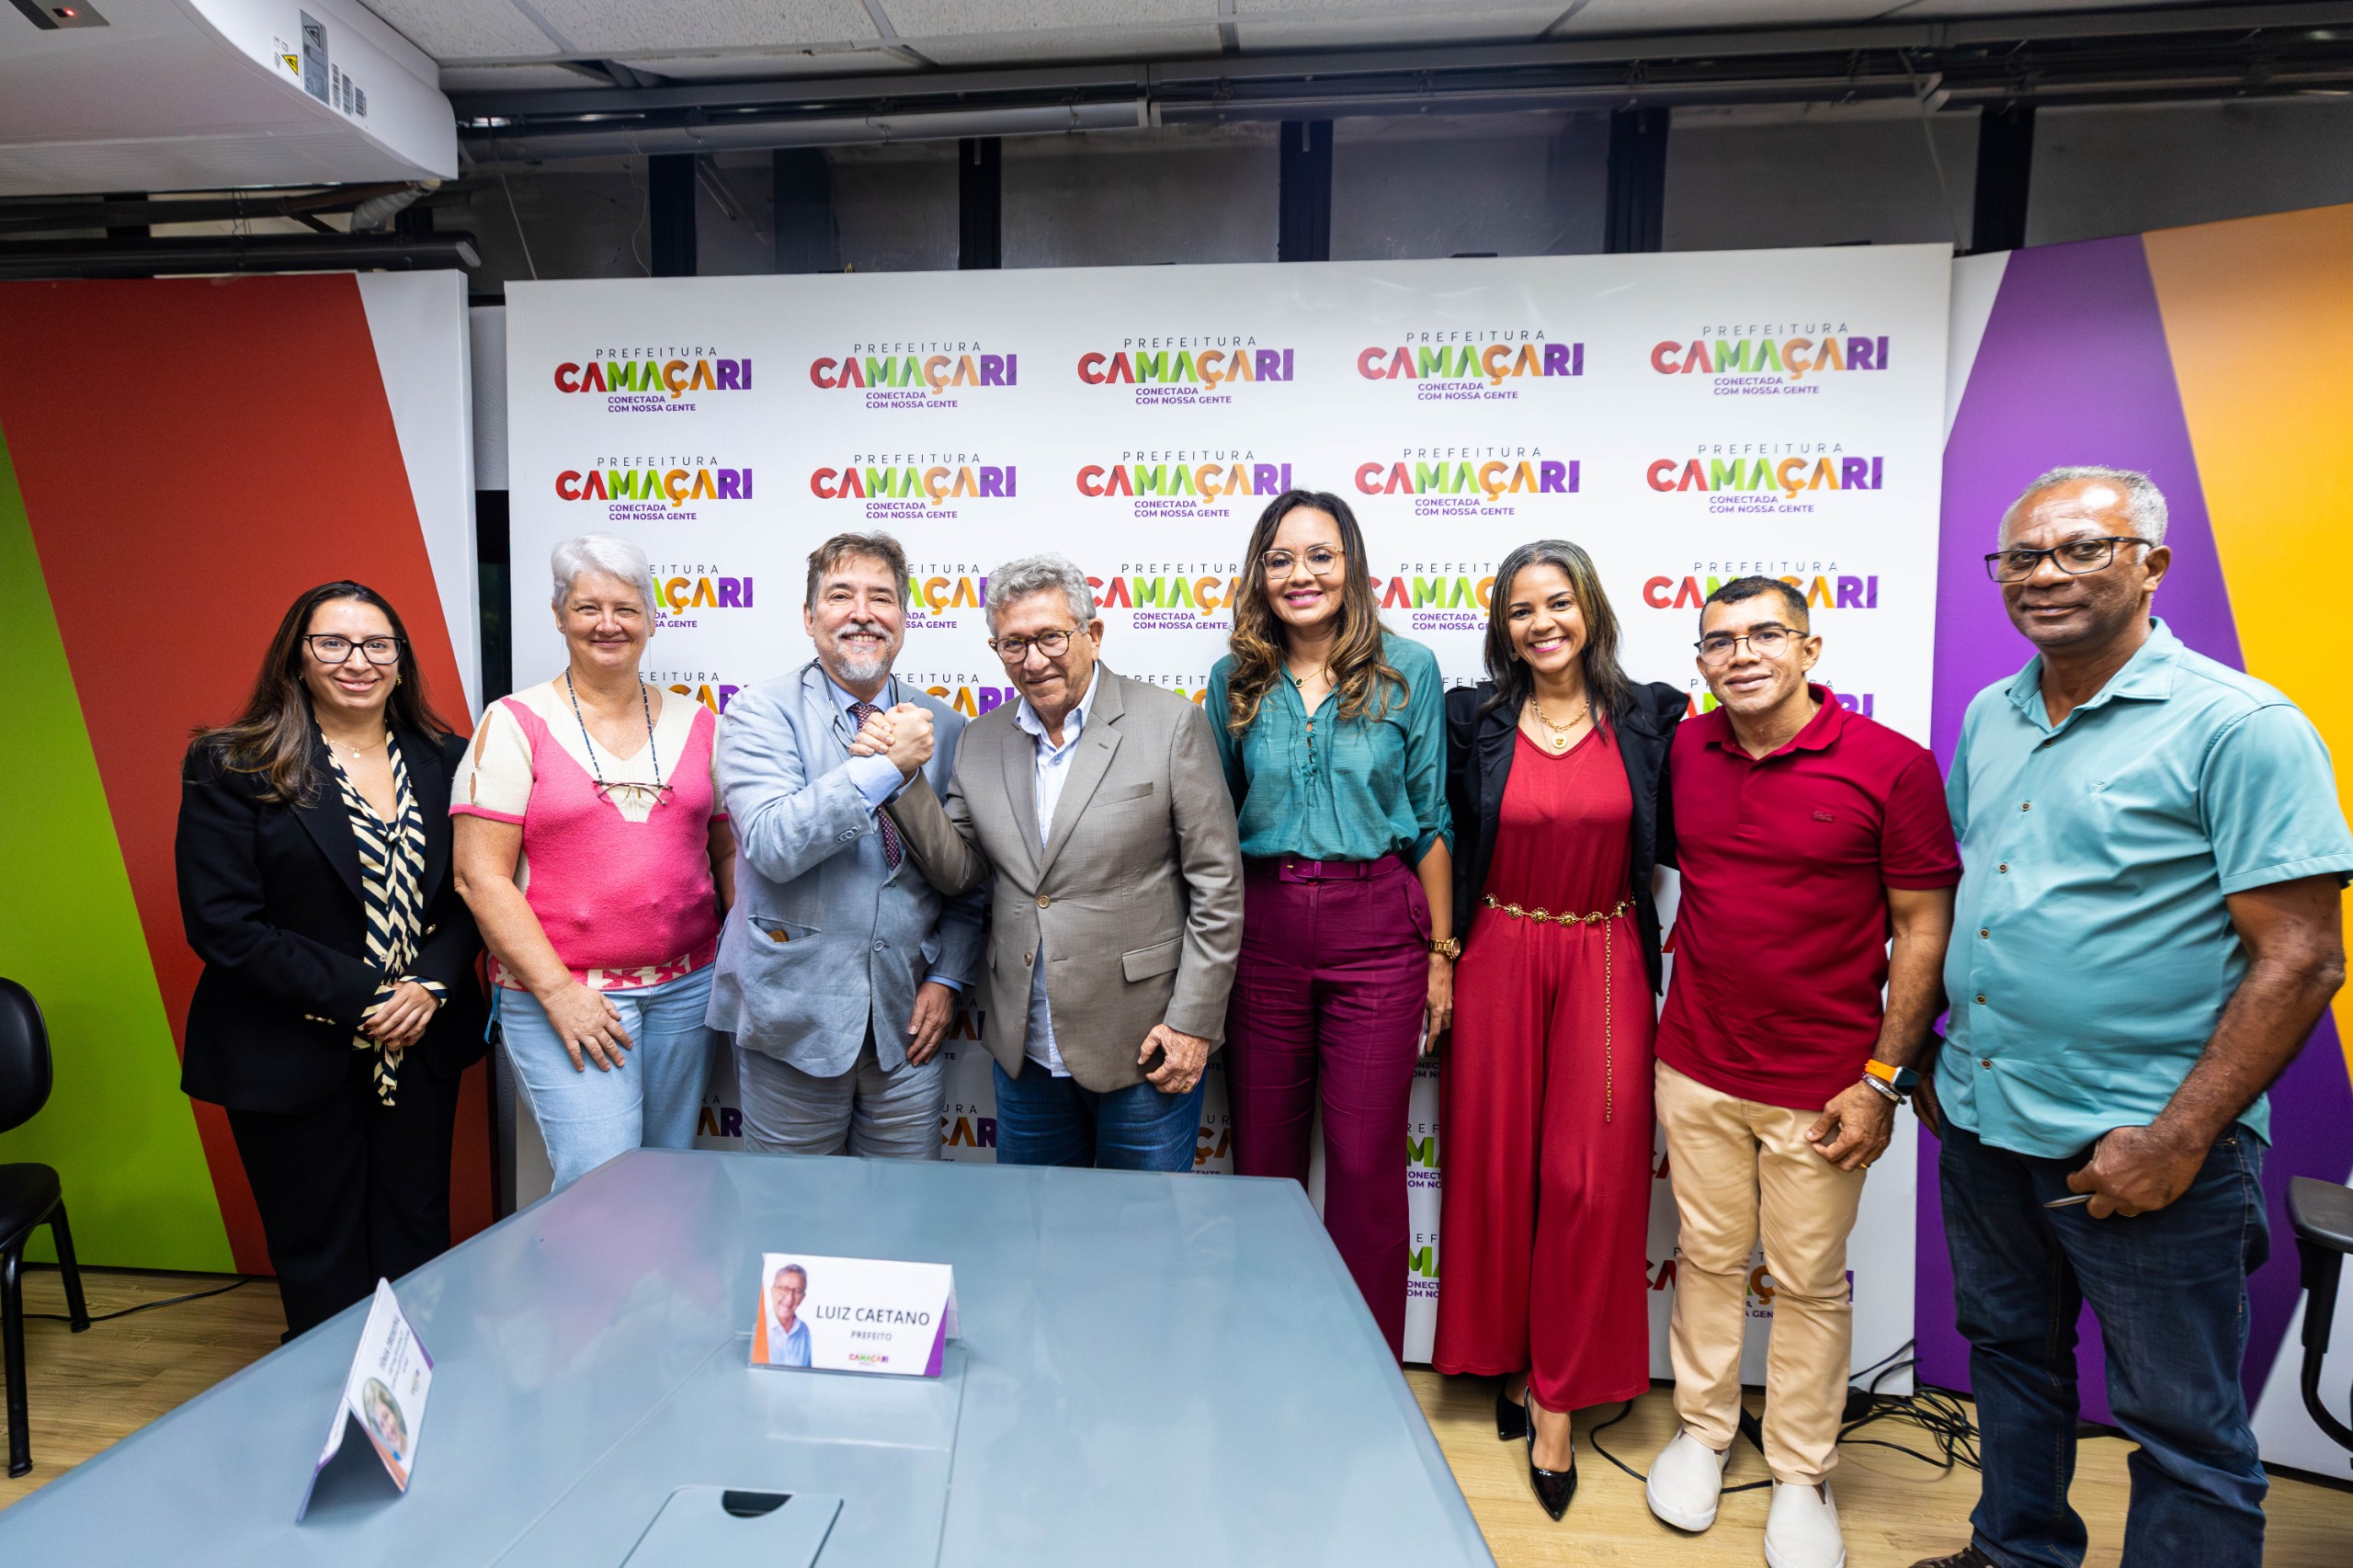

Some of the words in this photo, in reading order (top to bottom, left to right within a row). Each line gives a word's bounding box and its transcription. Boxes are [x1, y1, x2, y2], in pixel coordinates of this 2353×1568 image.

[1703, 323, 1847, 335] PREFEITURA
[1124, 336, 1256, 348] PREFEITURA
[1407, 330, 1544, 343] PREFEITURA
[597, 347, 716, 358] PREFEITURA
[855, 342, 980, 353] PREFEITURA
[1651, 335, 1889, 381] CAMAÇARI
[1077, 348, 1294, 391] CAMAÇARI
[1358, 343, 1585, 386] CAMAÇARI
[554, 358, 752, 399] CAMAÇARI
[810, 354, 1017, 394] CAMAÇARI
[1418, 382, 1483, 391] CONECTADA
[1714, 377, 1783, 385] CONECTADA
[1445, 392, 1481, 400] NOSSA
[1483, 391, 1518, 399] GENTE
[665, 403, 696, 412] GENTE
[1404, 448, 1540, 458] PREFEITURA
[1699, 443, 1842, 454] PREFEITURA
[855, 454, 980, 463] PREFEITURA
[1123, 450, 1254, 460] PREFEITURA
[597, 456, 718, 467] PREFEITURA
[1354, 460, 1580, 501] CAMAÇARI
[1647, 456, 1883, 499] CAMAÇARI
[555, 469, 753, 507] CAMAÇARI
[811, 466, 1016, 506] CAMAÇARI
[1076, 463, 1291, 504] CAMAÇARI
[650, 564, 719, 574] EITURA
[908, 564, 980, 574] EITURA
[1121, 563, 1237, 574] PREFEITUR
[1401, 563, 1501, 574] PREFEIT
[1694, 562, 1838, 572] PREFEITURA
[1412, 613, 1478, 621] CONECTADA
[1412, 622, 1437, 631] COM
[1439, 622, 1474, 631] NOSSA
[1408, 1180, 1425, 1188] OM
[1408, 1290, 1423, 1298] OM
[816, 1305, 850, 1321] LUIZ
[856, 1308, 930, 1325] CAETANO
[851, 1331, 892, 1342] PREFEITO
